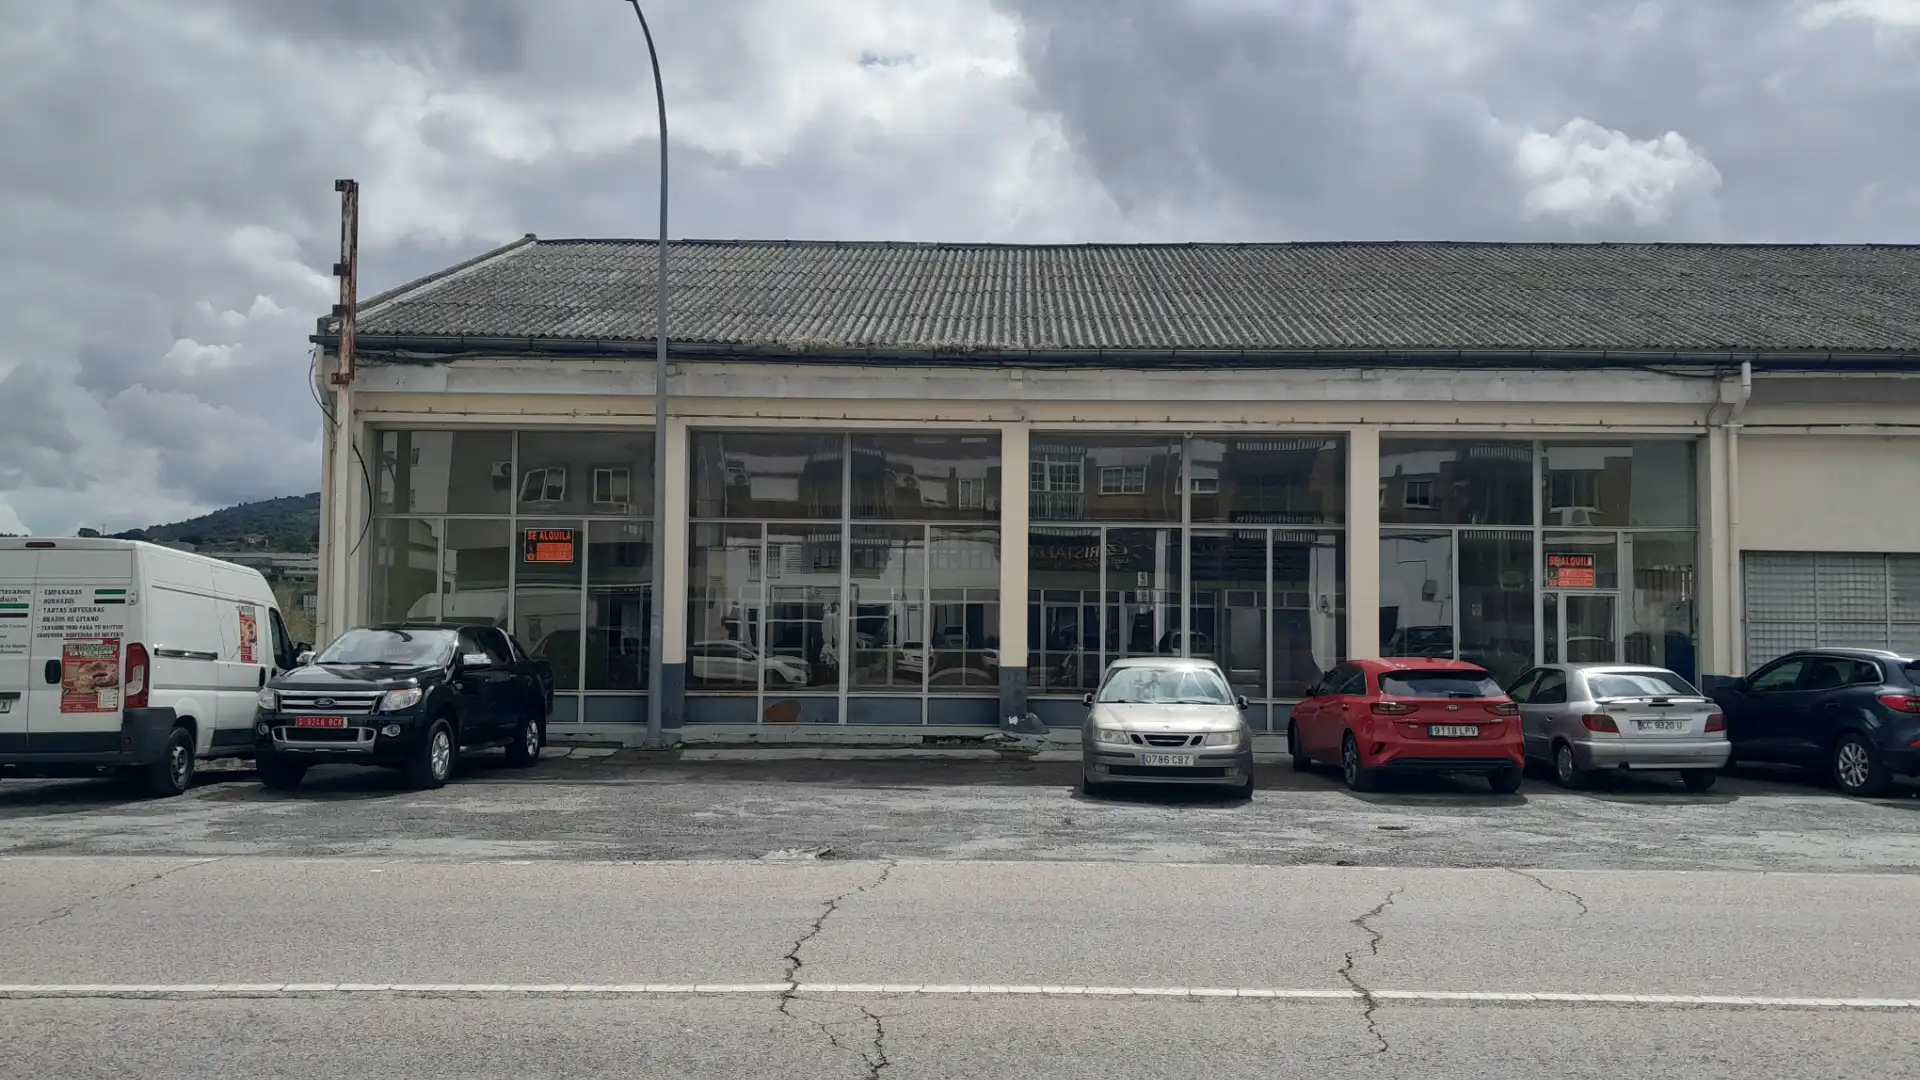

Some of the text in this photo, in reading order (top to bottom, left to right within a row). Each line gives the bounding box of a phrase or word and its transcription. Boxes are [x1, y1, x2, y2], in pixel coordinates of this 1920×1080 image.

[528, 531, 571, 540] SE ALQUILA
[1562, 556, 1593, 566] ALQUILA
[307, 718, 325, 726] 9248
[1642, 721, 1683, 730] CC 9320 U
[1434, 726, 1477, 736] 9118 LPV
[1145, 754, 1190, 765] 0786 CBZ
